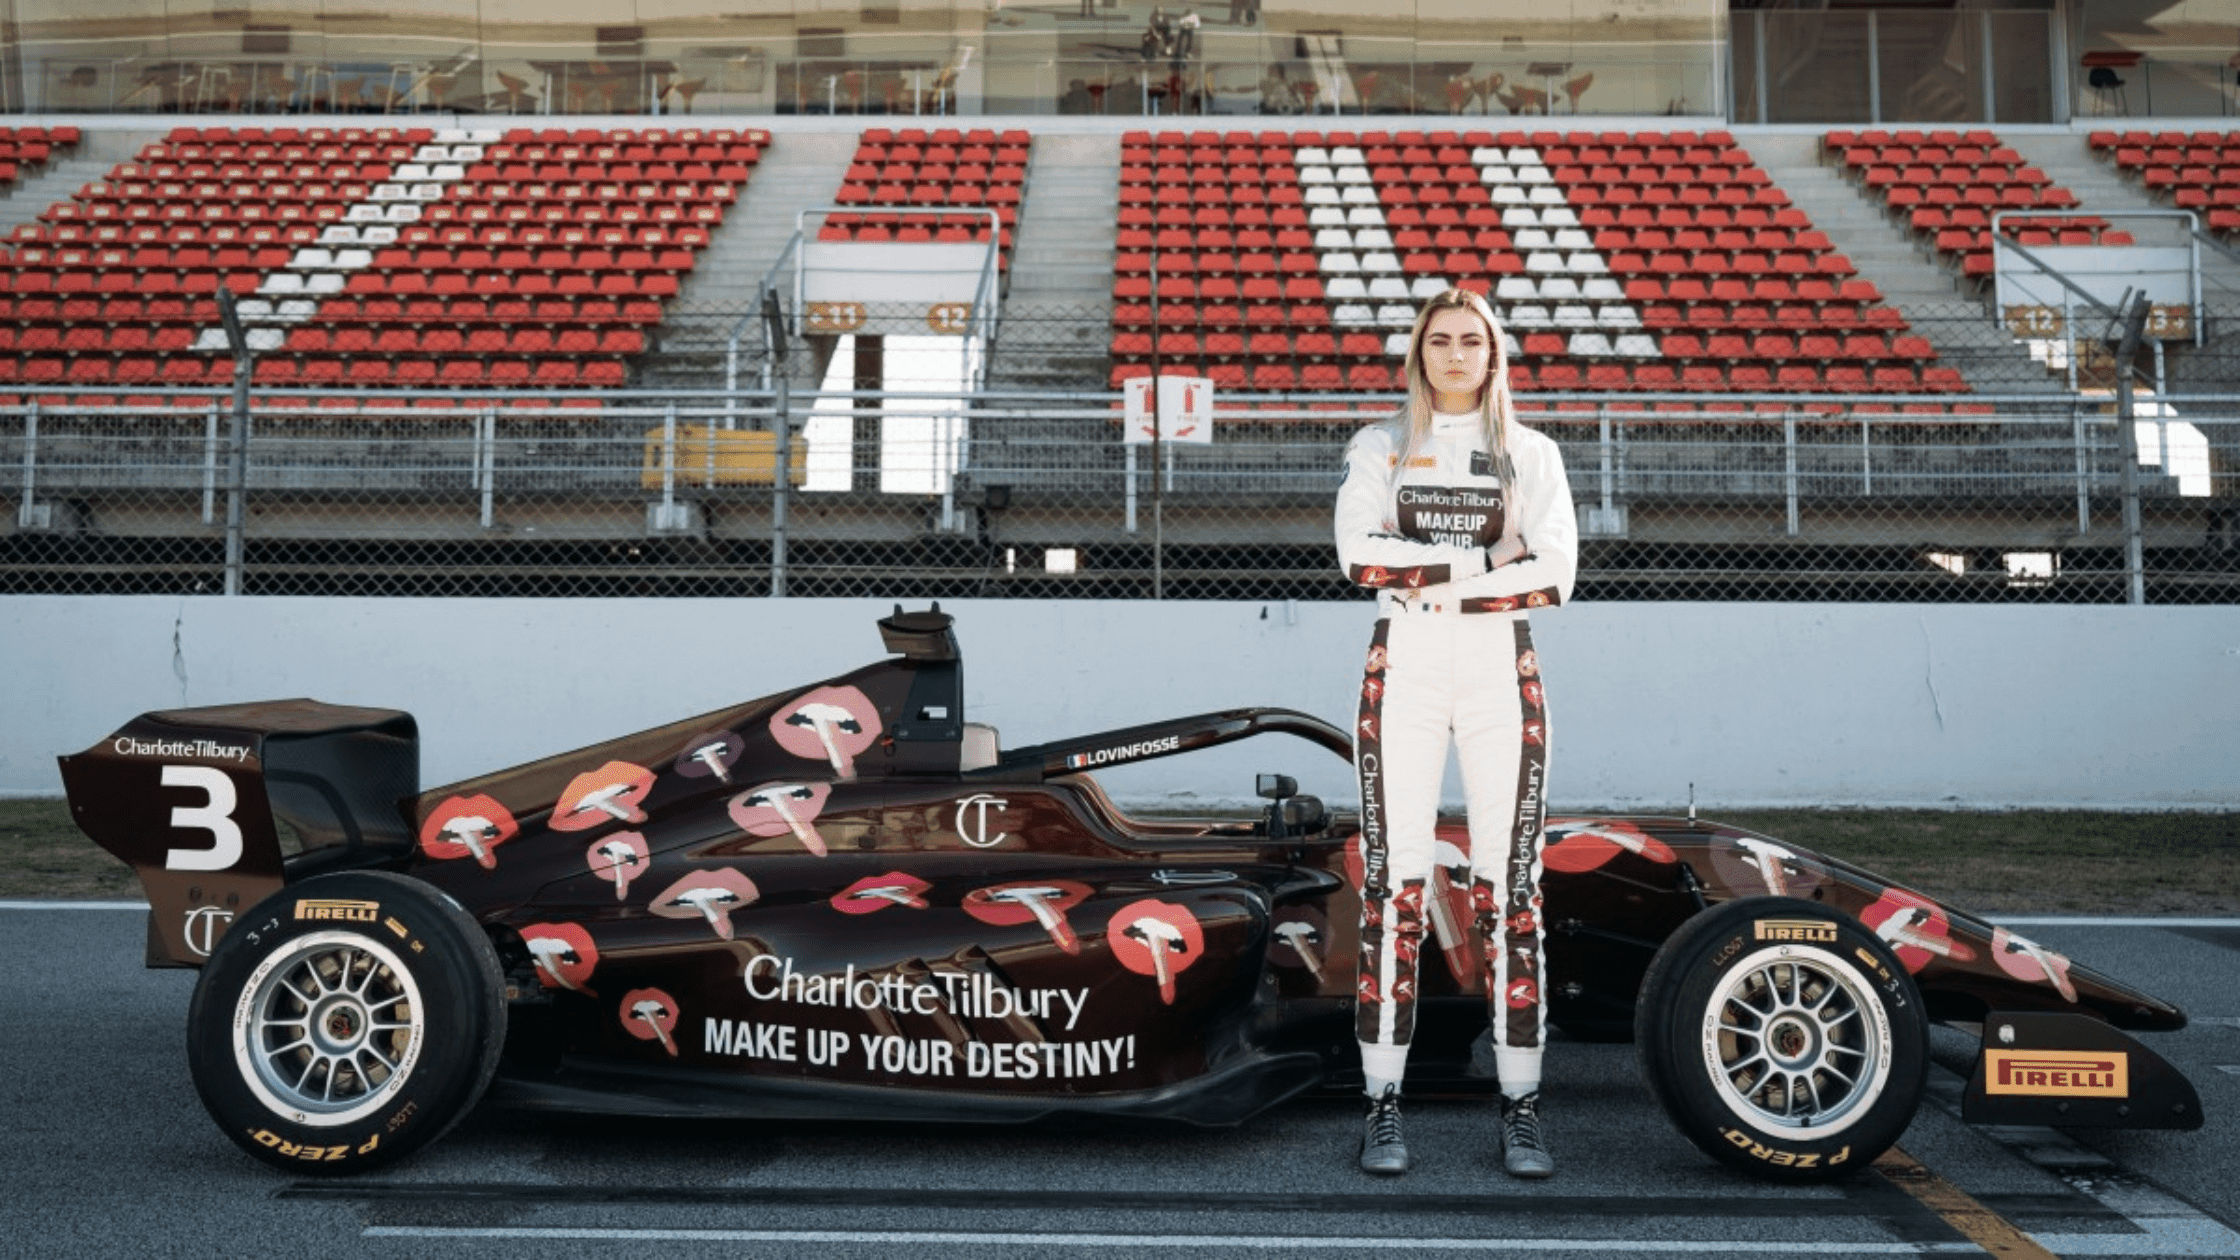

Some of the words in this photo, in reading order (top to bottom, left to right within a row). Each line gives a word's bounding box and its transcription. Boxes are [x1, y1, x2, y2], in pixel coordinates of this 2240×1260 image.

[829, 306, 857, 325] 11
[936, 307, 967, 328] 12
[2024, 310, 2054, 330] 12
[1415, 511, 1488, 531] MAKEUP
[1429, 532, 1474, 549] YOUR
[1087, 735, 1180, 765] LOVINFOSSE
[160, 765, 244, 871] 3
[294, 899, 380, 922] PIRELLI
[1754, 919, 1838, 942] PIRELLI
[704, 1016, 798, 1061] MAKE
[807, 1029, 850, 1067] UP
[860, 1033, 954, 1077] YOUR
[967, 1034, 1136, 1078] DESTINY!
[1998, 1058, 2115, 1087] PIRELLI
[252, 1129, 350, 1161] ZERO
[358, 1133, 380, 1155] P
[1724, 1128, 1821, 1168] ZERO
[1829, 1145, 1850, 1167] P
